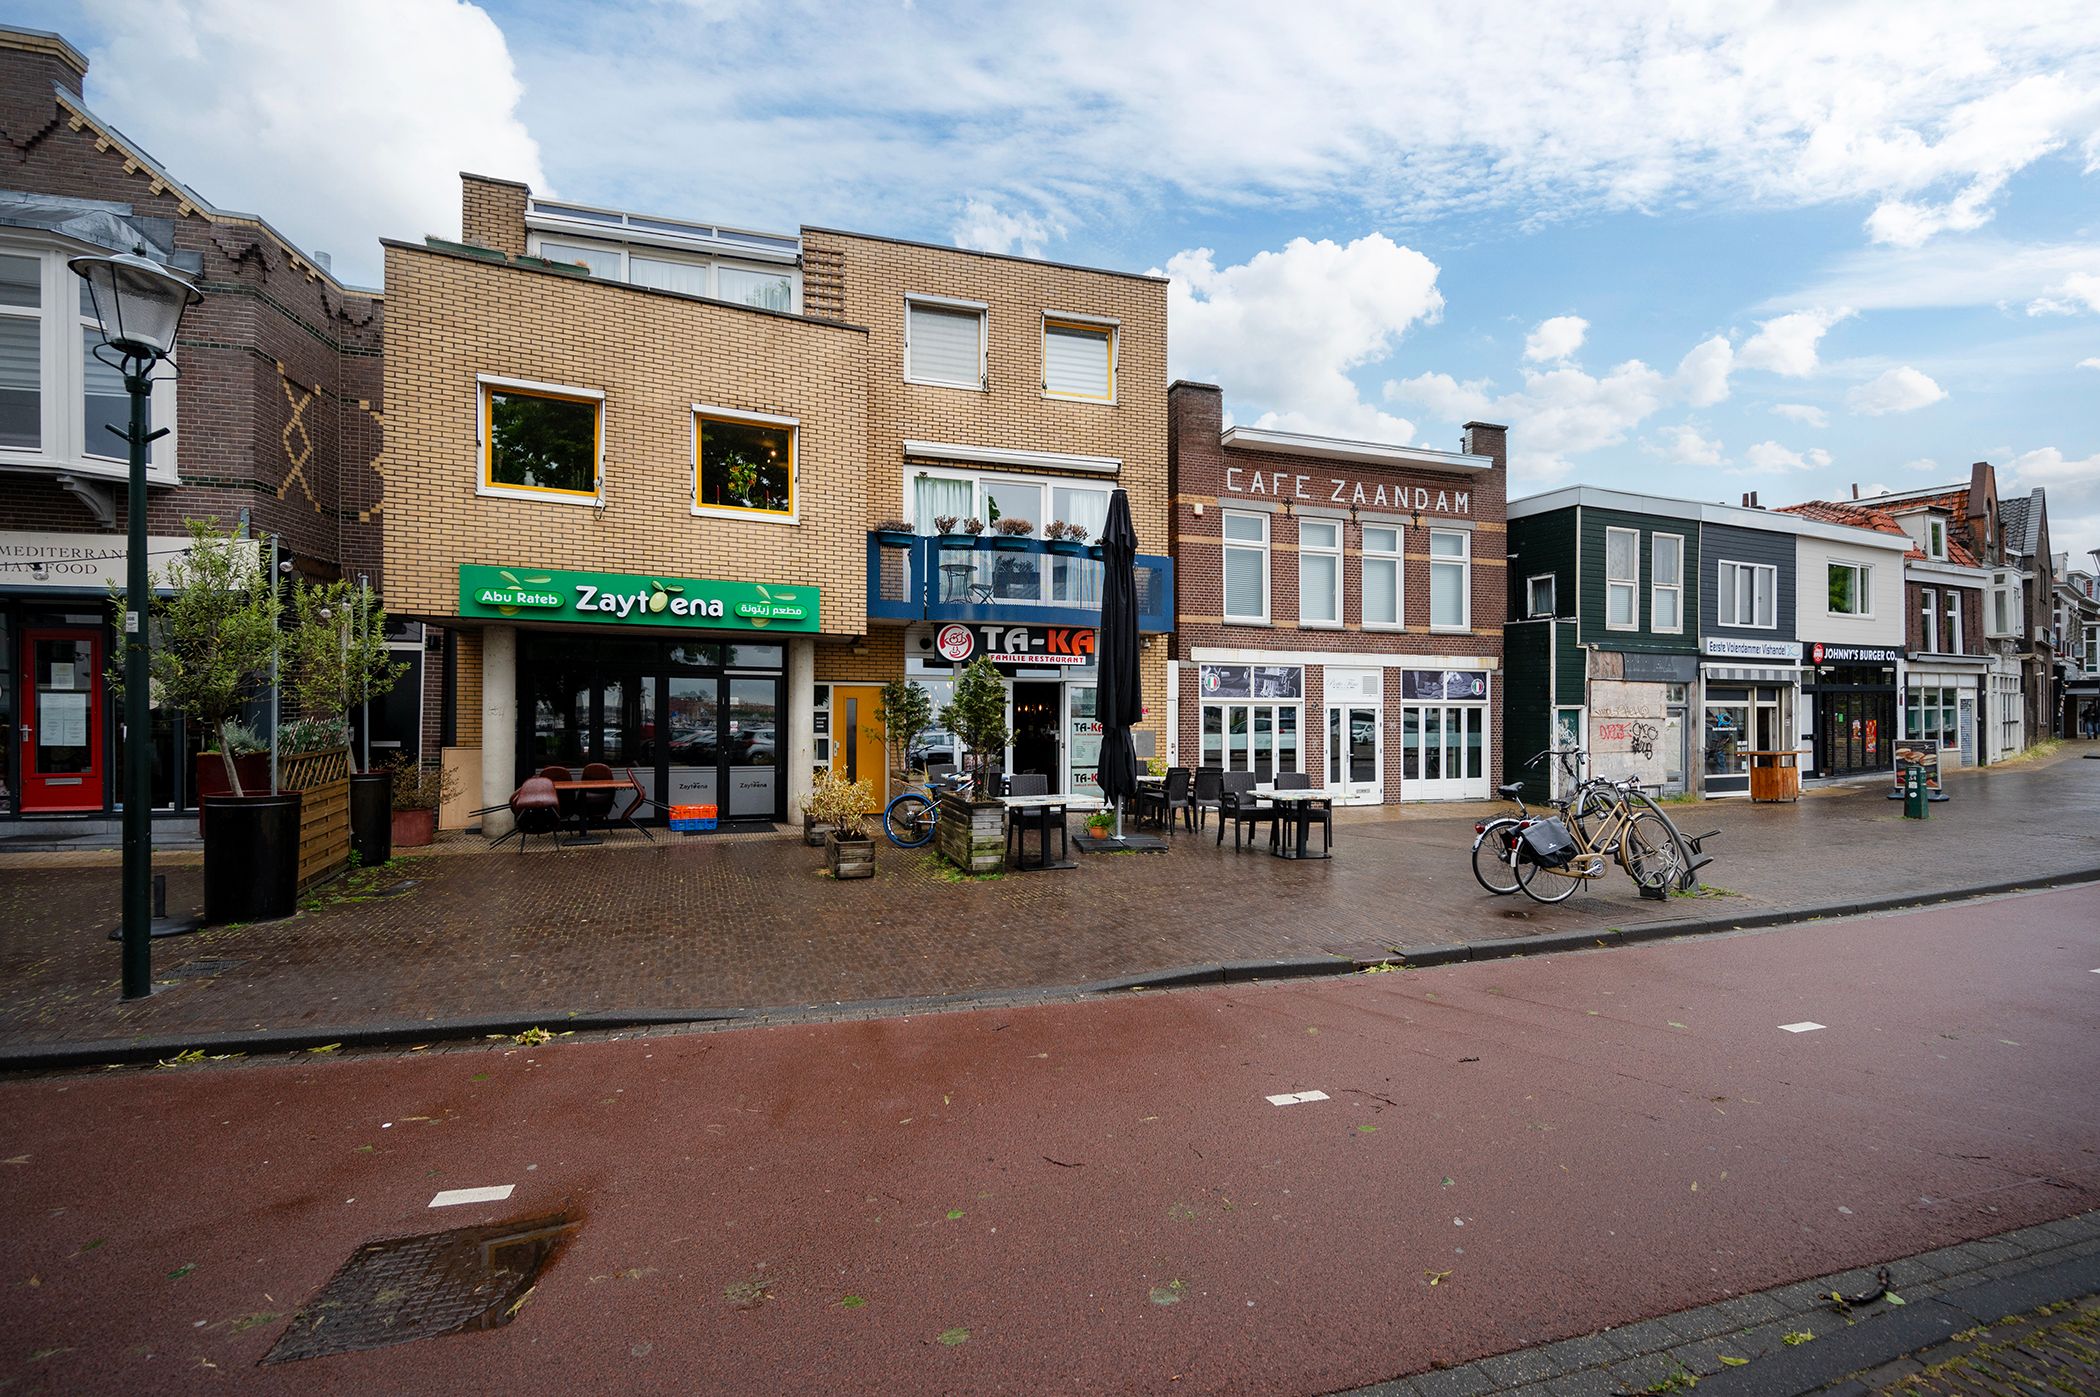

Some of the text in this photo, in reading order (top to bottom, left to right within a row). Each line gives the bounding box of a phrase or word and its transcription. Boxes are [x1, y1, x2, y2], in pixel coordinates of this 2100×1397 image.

[1227, 467, 1468, 514] CAFE ZAANDAM
[0, 546, 129, 559] MEDITERRAN
[45, 562, 98, 575] FOOD
[481, 590, 558, 605] Abu Rateb
[740, 603, 802, 616] مطعم زيتونة
[980, 626, 1095, 657] TA-KA
[990, 654, 1084, 664] FAMILIE RESTAURANT
[1824, 647, 1858, 660] JOHNNY'S
[1859, 649, 1885, 661] BURGER
[1886, 650, 1897, 661] CO.
